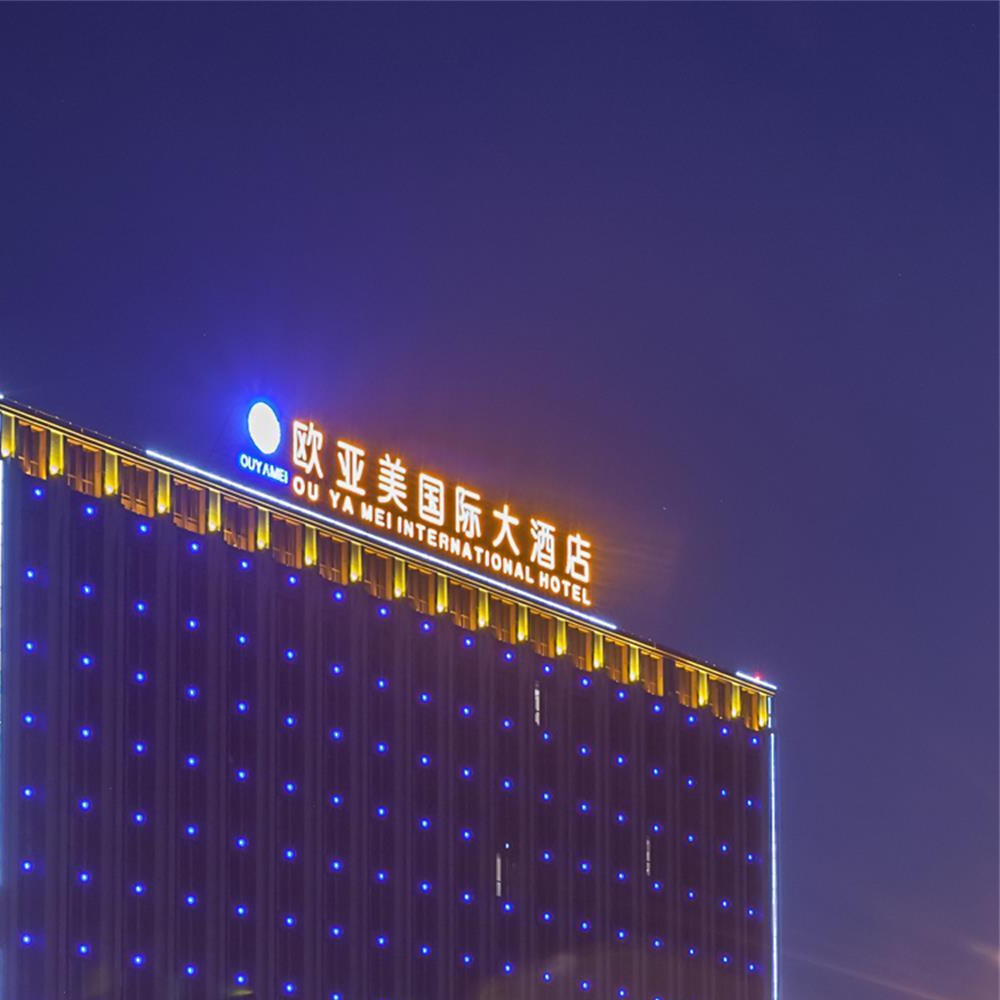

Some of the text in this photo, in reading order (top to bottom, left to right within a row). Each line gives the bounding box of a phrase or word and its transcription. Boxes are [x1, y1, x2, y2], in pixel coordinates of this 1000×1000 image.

[239, 453, 288, 484] OUYAMEI
[293, 420, 592, 583] 欧亚美国际大酒店
[292, 476, 592, 606] OU YA MEI INTERNATIONAL HOTEL
